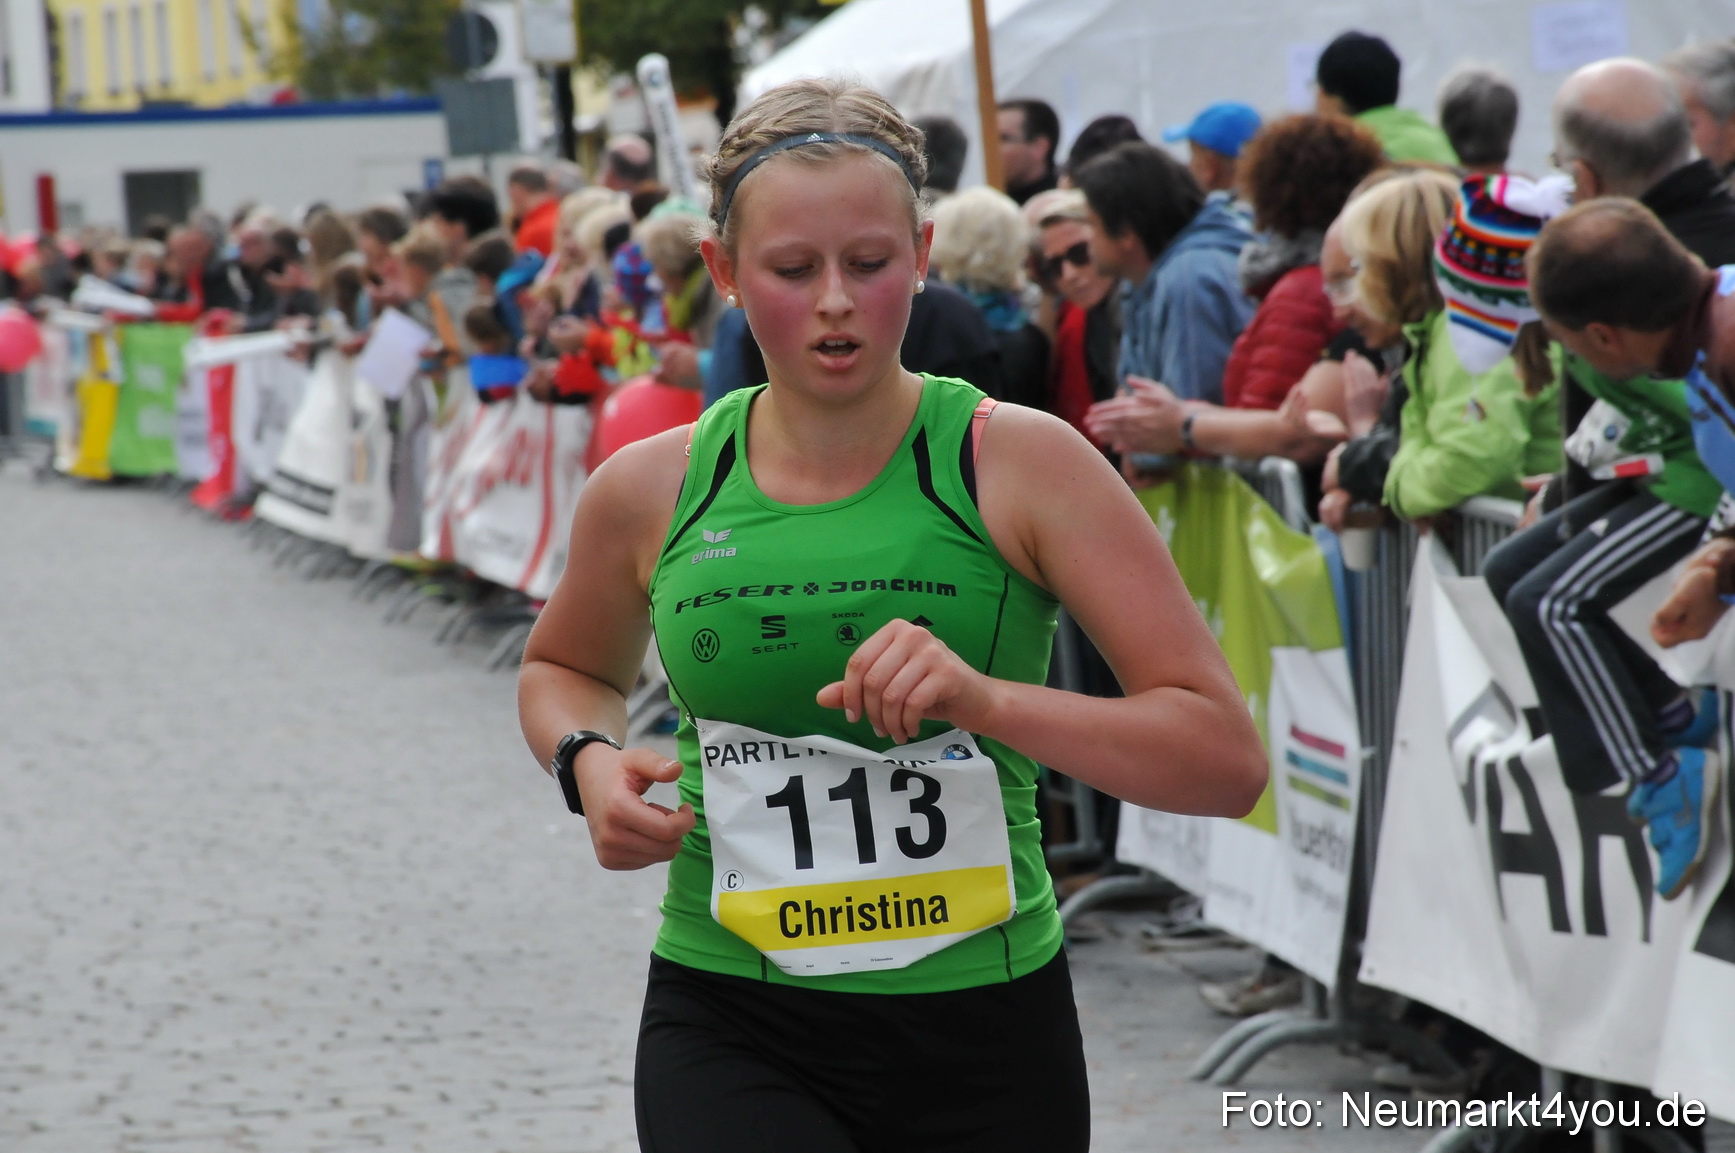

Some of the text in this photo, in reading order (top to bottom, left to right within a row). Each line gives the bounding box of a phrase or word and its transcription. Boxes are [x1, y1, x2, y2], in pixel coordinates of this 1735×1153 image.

[691, 547, 737, 565] erima
[675, 578, 957, 614] FESER JOACHIM
[751, 642, 800, 655] SEAT
[765, 766, 948, 870] 113
[727, 873, 738, 890] C
[778, 891, 950, 939] Christina
